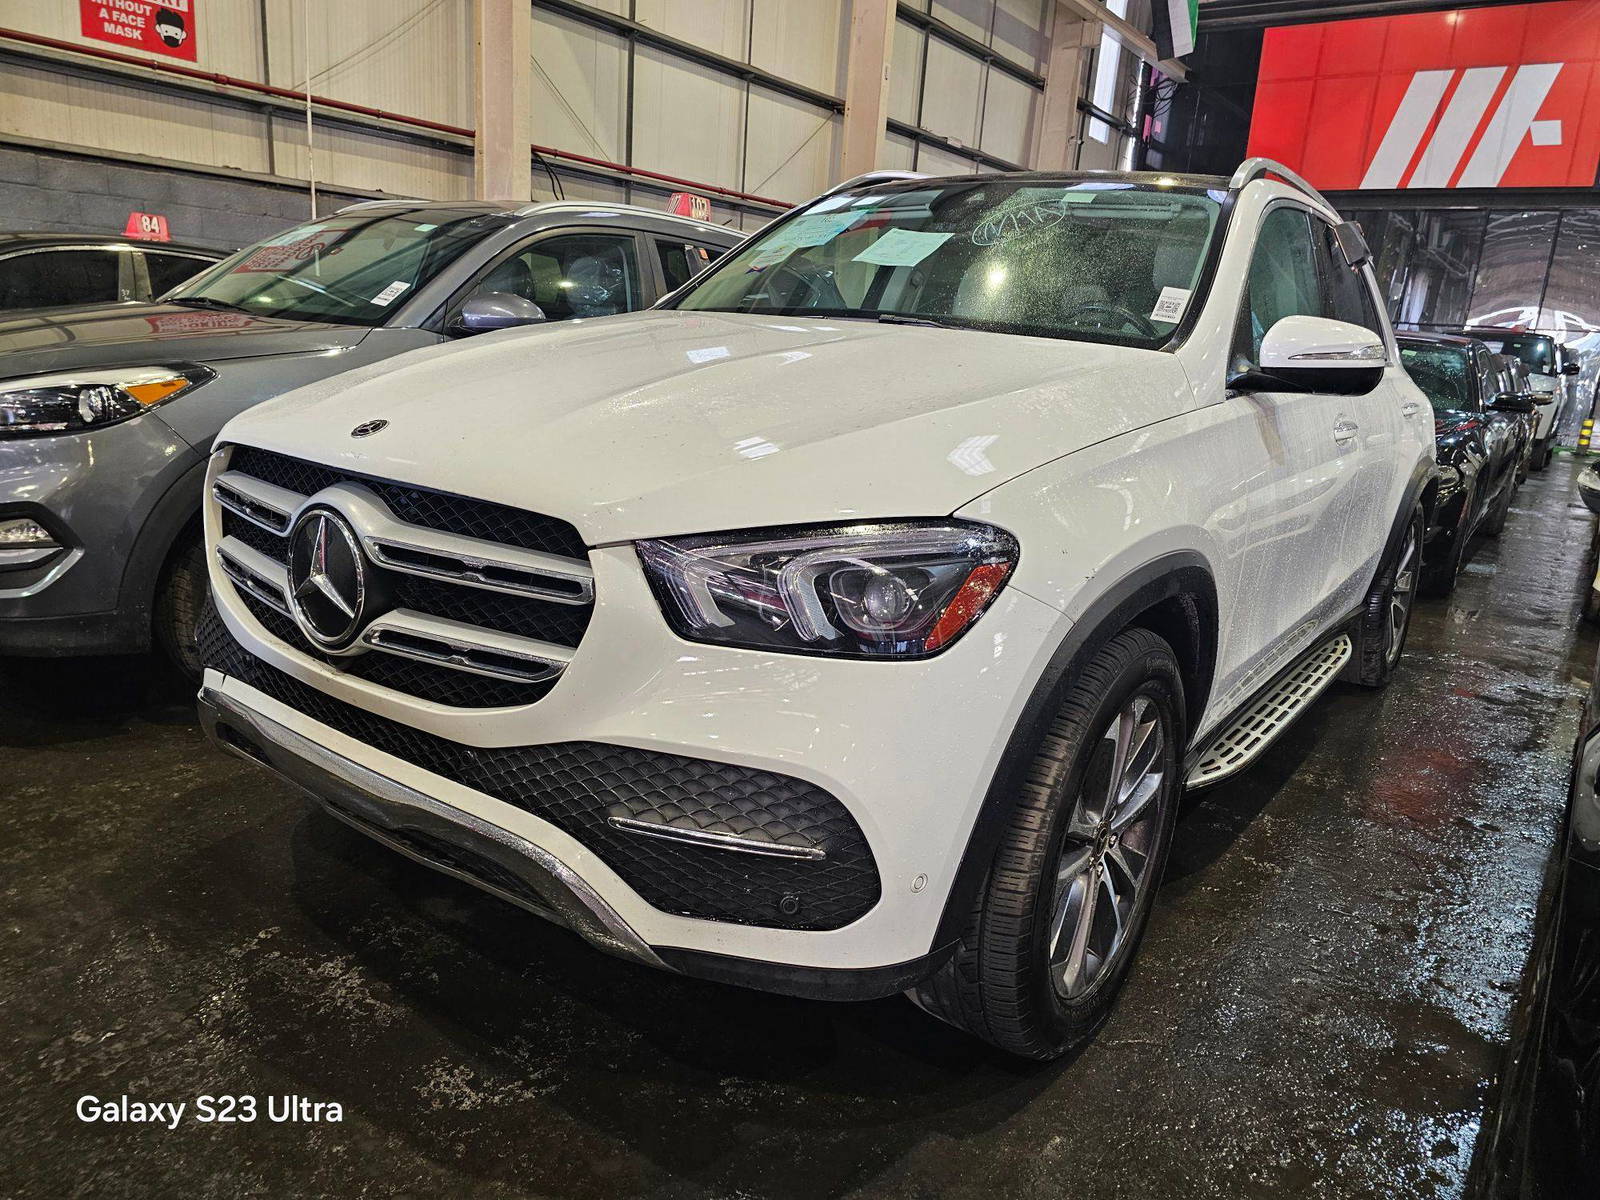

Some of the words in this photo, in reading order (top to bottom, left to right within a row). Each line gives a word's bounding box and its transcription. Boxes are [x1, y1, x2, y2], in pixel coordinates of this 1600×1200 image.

[92, 0, 152, 16] THOUT
[99, 8, 109, 19] A
[112, 10, 146, 28] FACE
[104, 22, 143, 40] MASK
[141, 215, 160, 234] 84
